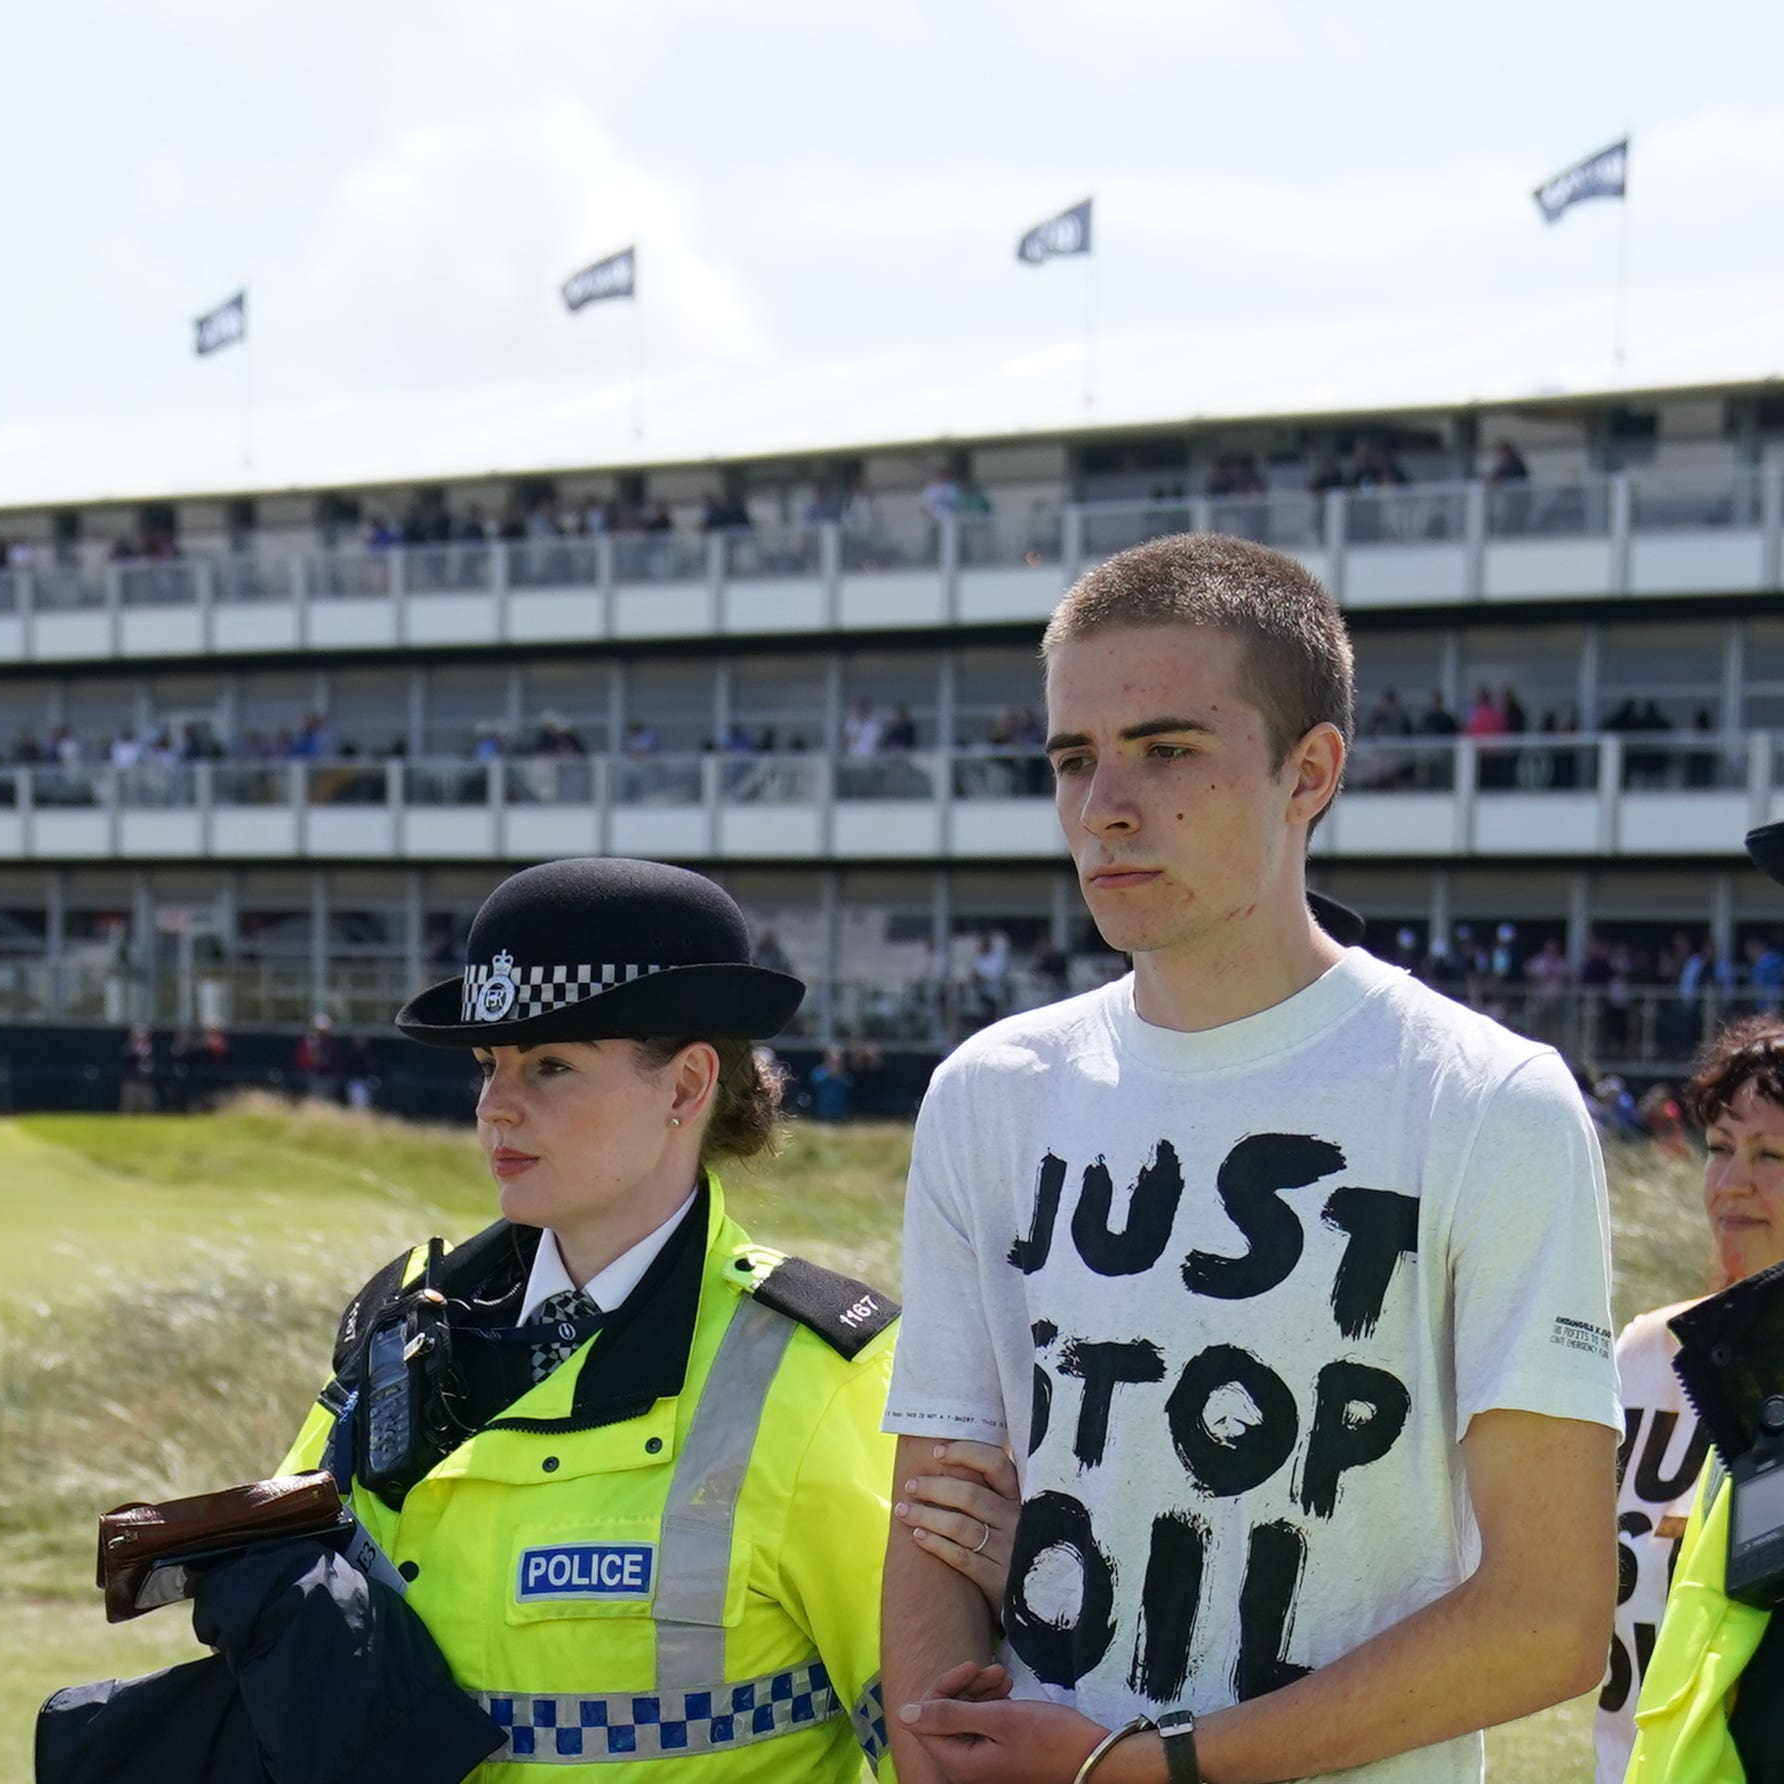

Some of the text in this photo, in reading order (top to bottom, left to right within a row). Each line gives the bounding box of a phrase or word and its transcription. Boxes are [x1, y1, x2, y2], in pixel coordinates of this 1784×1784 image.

[839, 1295, 879, 1329] 1167
[1006, 1132, 1419, 1340] JUST
[1028, 1318, 1412, 1520] TOP
[528, 1553, 644, 1588] POLICE
[1004, 1489, 1315, 1704] OIL
